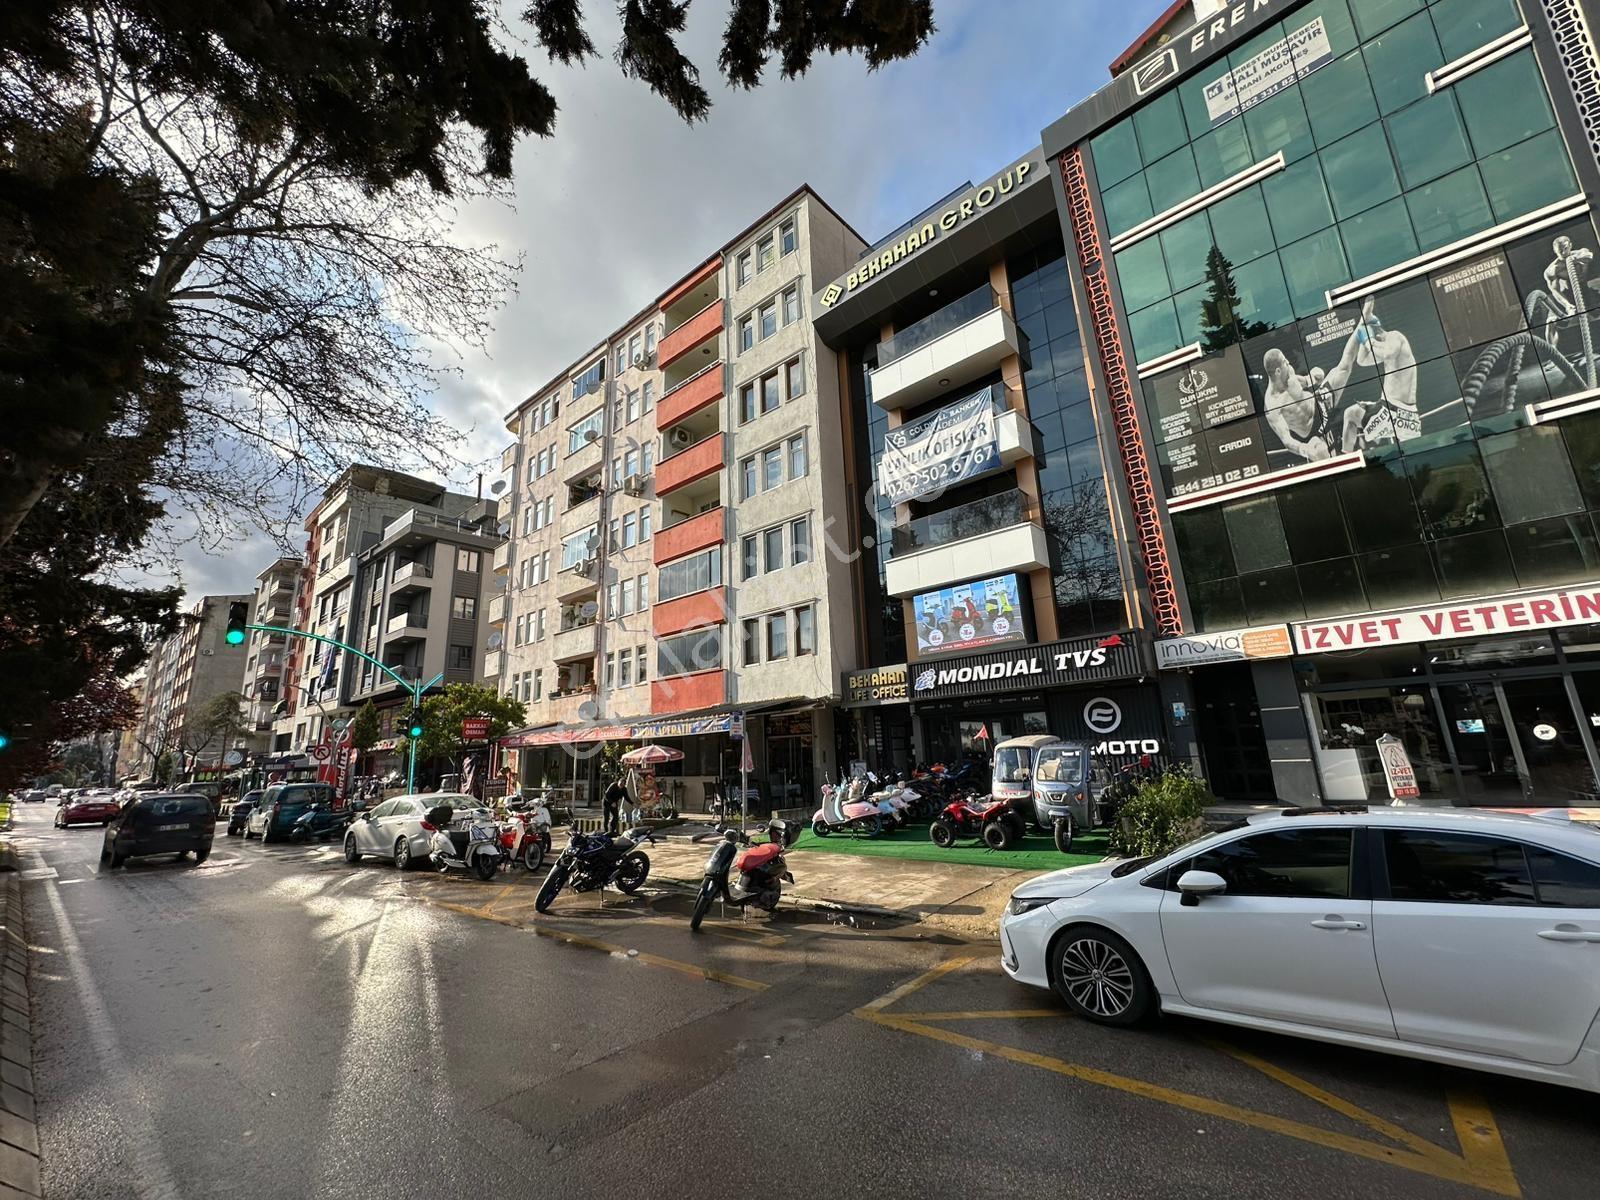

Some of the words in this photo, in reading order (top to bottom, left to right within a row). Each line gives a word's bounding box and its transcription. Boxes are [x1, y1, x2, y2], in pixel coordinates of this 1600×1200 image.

[1225, 57, 1261, 81] SERBEST
[1227, 66, 1258, 90] MALİ
[1261, 27, 1323, 69] MÜŞAVİR
[846, 223, 937, 293] BEKAHAN
[939, 161, 1031, 231] GROUP
[1444, 267, 1500, 294] ANTREMAN
[1317, 312, 1337, 323] KEEP
[1318, 318, 1339, 330] CALM
[1306, 331, 1321, 341] AND
[1322, 319, 1356, 336] TRAINING
[1179, 385, 1218, 404] DURUKAN
[909, 413, 949, 436] COLDWLL
[950, 399, 981, 417] BANKER
[1219, 437, 1252, 454] CARDIO
[887, 474, 920, 498] 0262
[922, 463, 949, 485] 502
[973, 445, 993, 464] 67
[1225, 469, 1241, 483] 02
[1243, 464, 1260, 478] 20
[1301, 617, 1402, 650] İZVET
[1420, 591, 1600, 636] VETERİN
[1161, 635, 1240, 658] innovia
[938, 659, 1042, 685] MONDIAL
[1054, 648, 1106, 671] TVS
[849, 670, 907, 688] BEKAHAN
[851, 687, 869, 701] LIFE
[872, 683, 907, 699] OFFICE
[1061, 739, 1160, 756] MOTO
